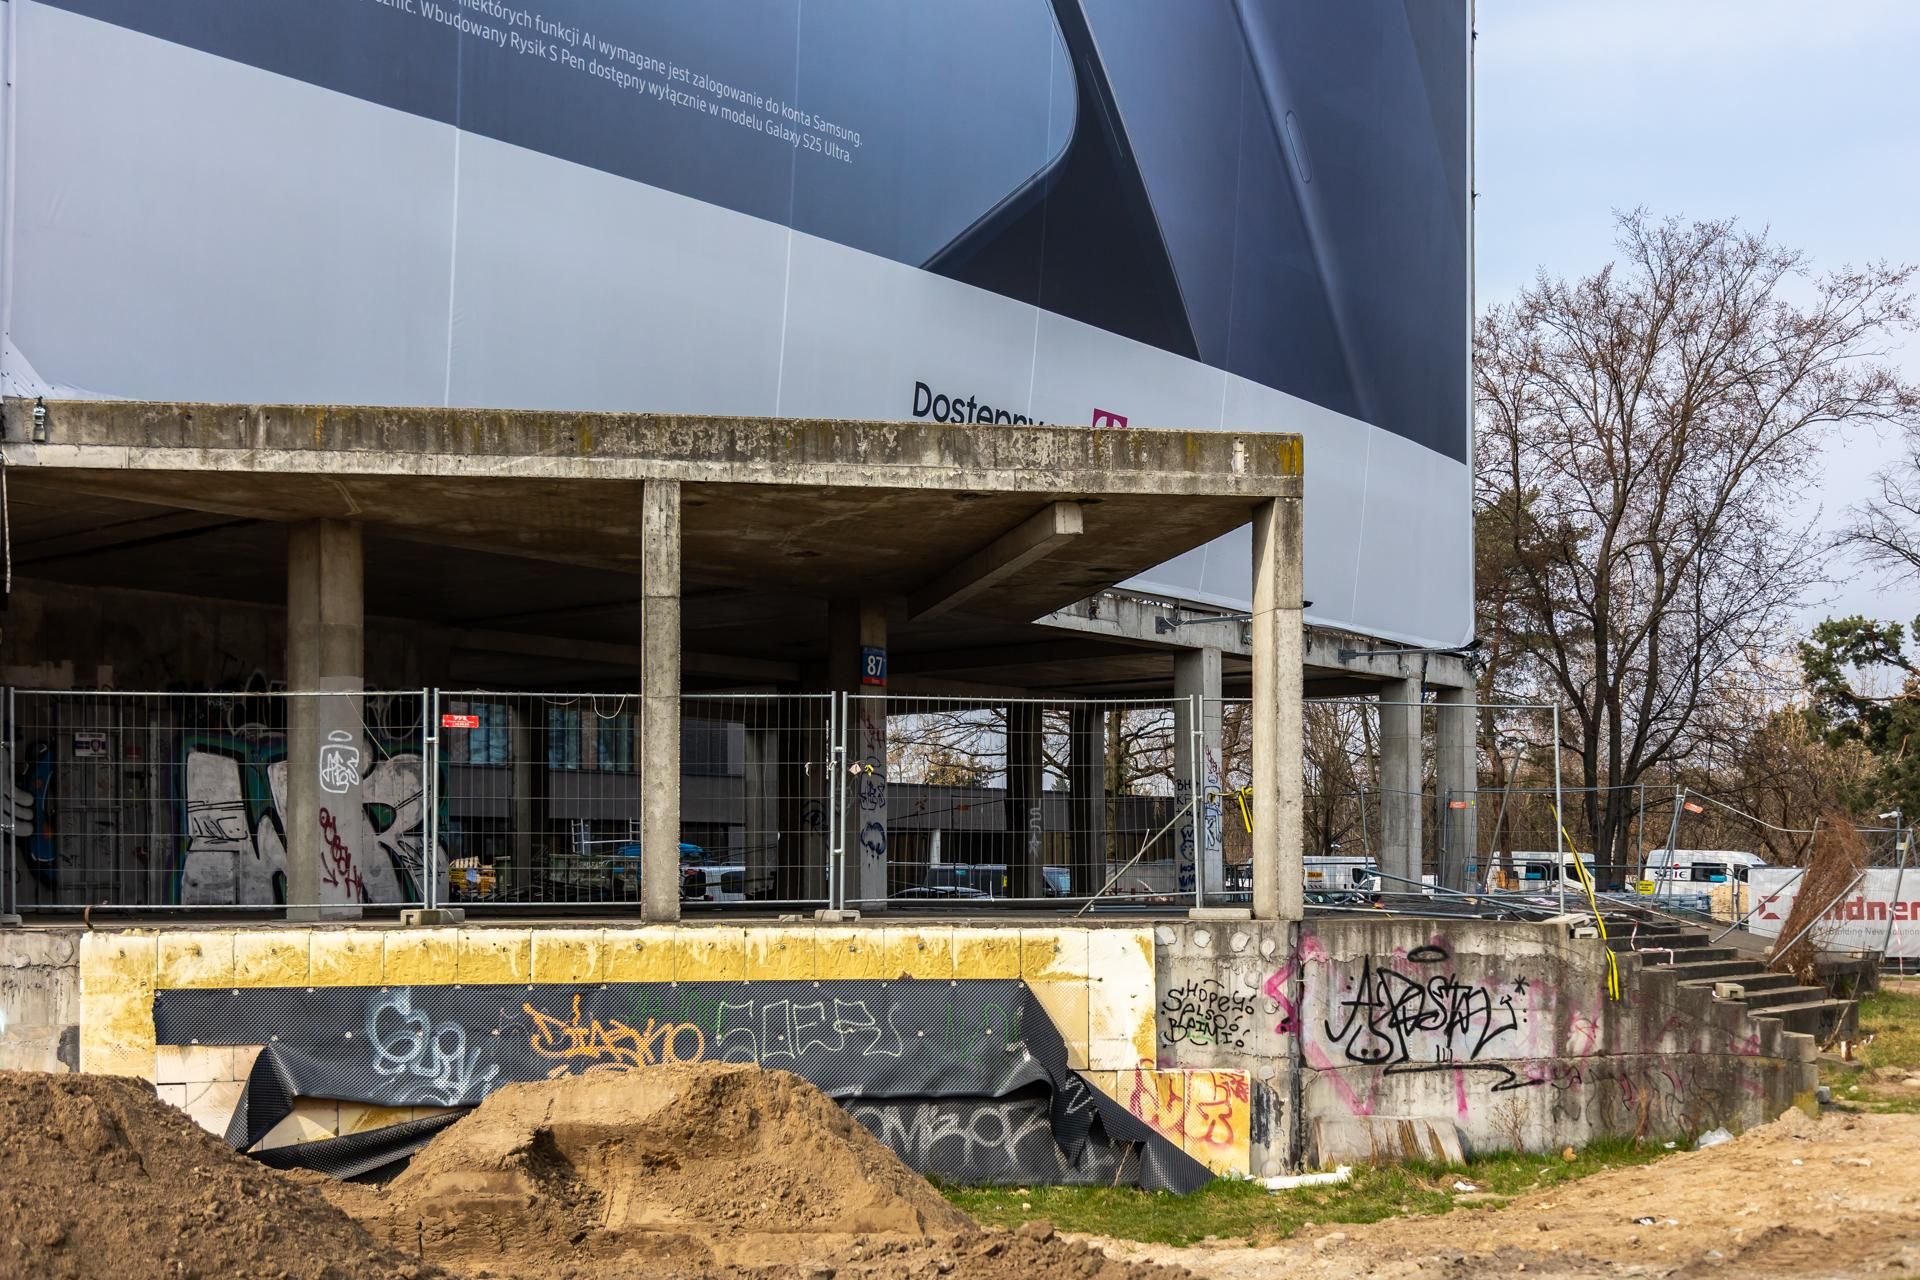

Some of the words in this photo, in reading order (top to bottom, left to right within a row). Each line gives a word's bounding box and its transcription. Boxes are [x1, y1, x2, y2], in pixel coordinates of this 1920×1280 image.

[420, 1, 507, 48] Wbudowany
[510, 31, 546, 58] Rysik
[549, 44, 558, 61] S
[561, 48, 585, 71] Pen
[589, 58, 646, 94] dostępny
[648, 81, 707, 112] wyłącznie
[709, 102, 719, 116] w
[721, 106, 763, 131] modelu
[765, 119, 801, 148] Galaxy
[803, 133, 822, 152] S25
[824, 141, 853, 164] Ultra.
[535, 14, 580, 47] funkcji
[582, 32, 596, 50] AI
[599, 40, 666, 75] wymagane
[668, 62, 690, 83] jest
[693, 73, 763, 109] zalogowanie
[765, 97, 779, 114] do
[782, 101, 811, 127] konta
[813, 115, 863, 148] Samsung.
[867, 655, 884, 677] 87
